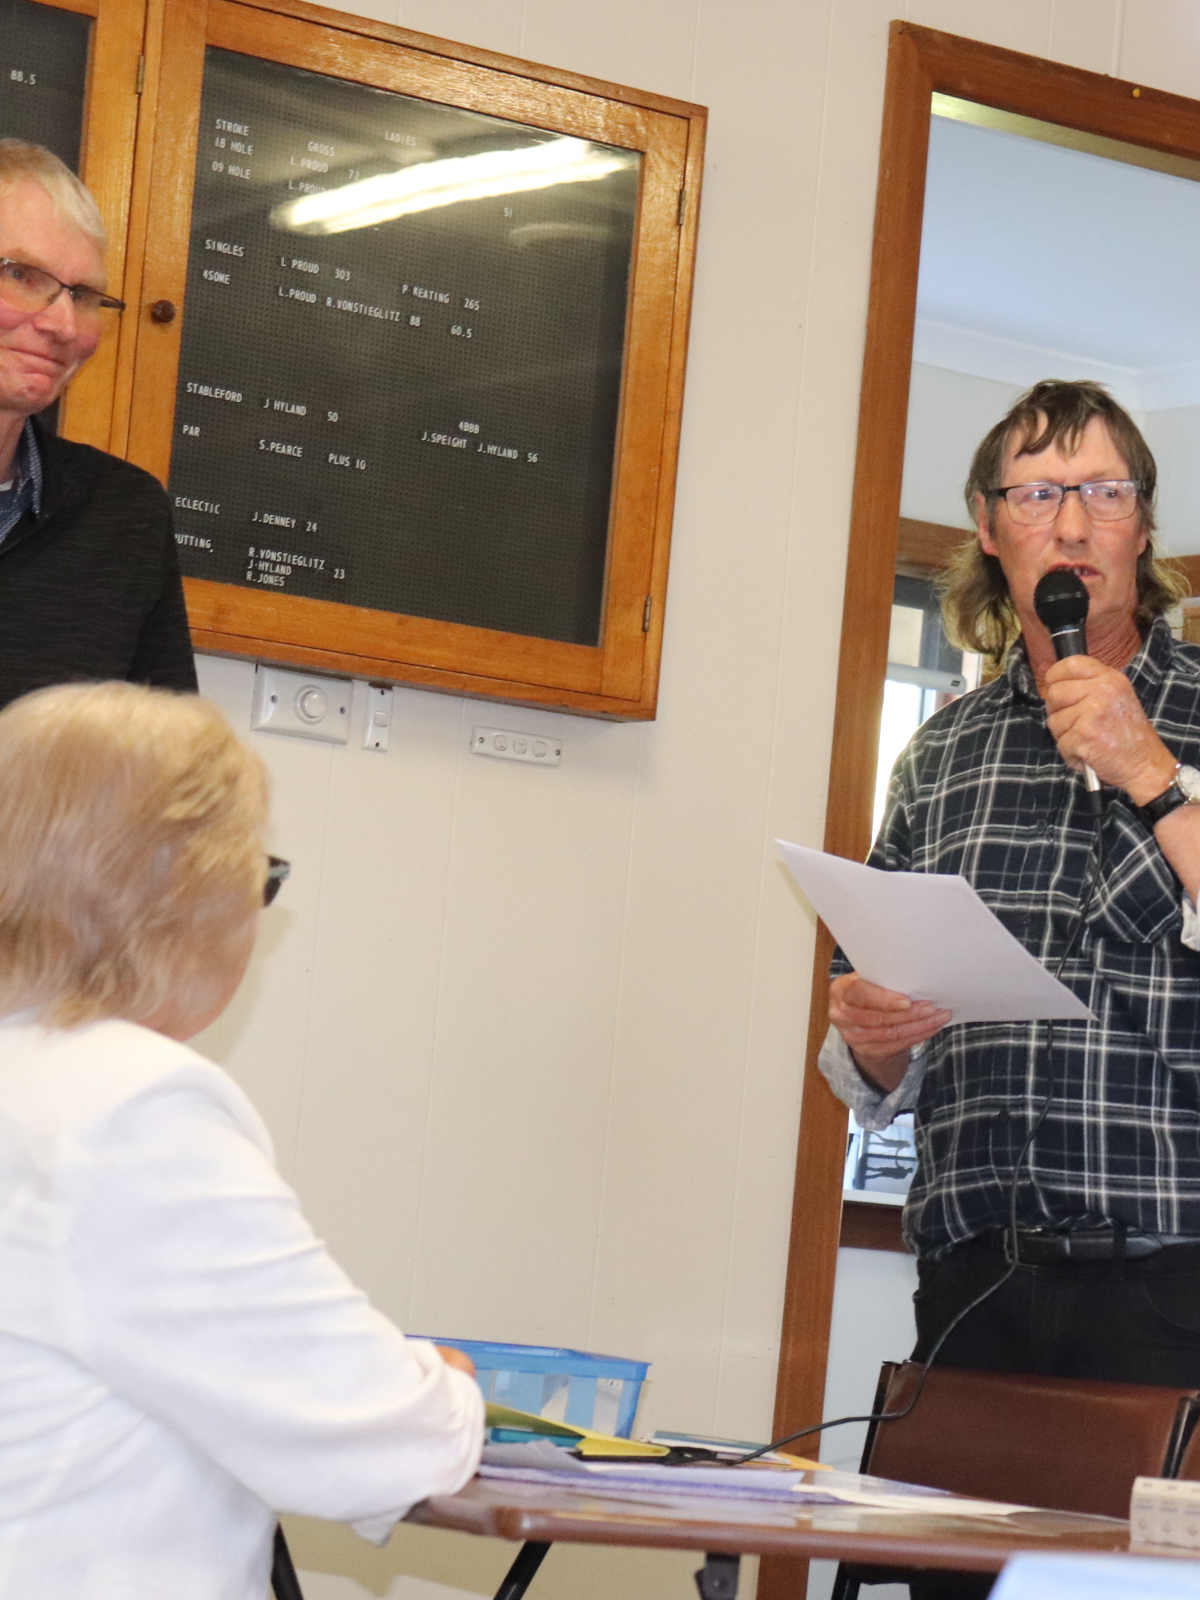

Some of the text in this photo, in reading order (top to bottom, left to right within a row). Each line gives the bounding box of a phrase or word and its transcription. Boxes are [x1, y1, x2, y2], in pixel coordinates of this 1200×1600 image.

[10, 70, 36, 85] 88.5
[215, 119, 249, 136] STROKE
[215, 137, 253, 155] 18 HOLE
[385, 131, 416, 146] LADIES
[308, 141, 335, 157] GROSS
[212, 161, 251, 179] 09 HOLE
[290, 156, 328, 172] L.PROUD
[205, 239, 244, 257] SINGLES
[203, 270, 231, 284] 4SOME
[281, 257, 350, 281] L PROUD 303
[279, 286, 316, 303] L.PROUD
[402, 284, 480, 310] P KEATING 265
[451, 325, 472, 338] 60.5
[186, 382, 242, 402] STABLEFORD
[263, 398, 338, 422] J HYLAND 50
[182, 424, 200, 437] PAR
[259, 439, 303, 457] S.PEARCE
[328, 453, 350, 466] PLUS
[421, 431, 538, 463] J.SPEIGHT J.HYLAND 56
[175, 497, 220, 514] ECLECTIC
[252, 512, 317, 532] J.DENNEY 24
[248, 547, 325, 570] R.VONSTIEGLITZ
[246, 571, 285, 586] R.JONES
[334, 568, 345, 579] 23
